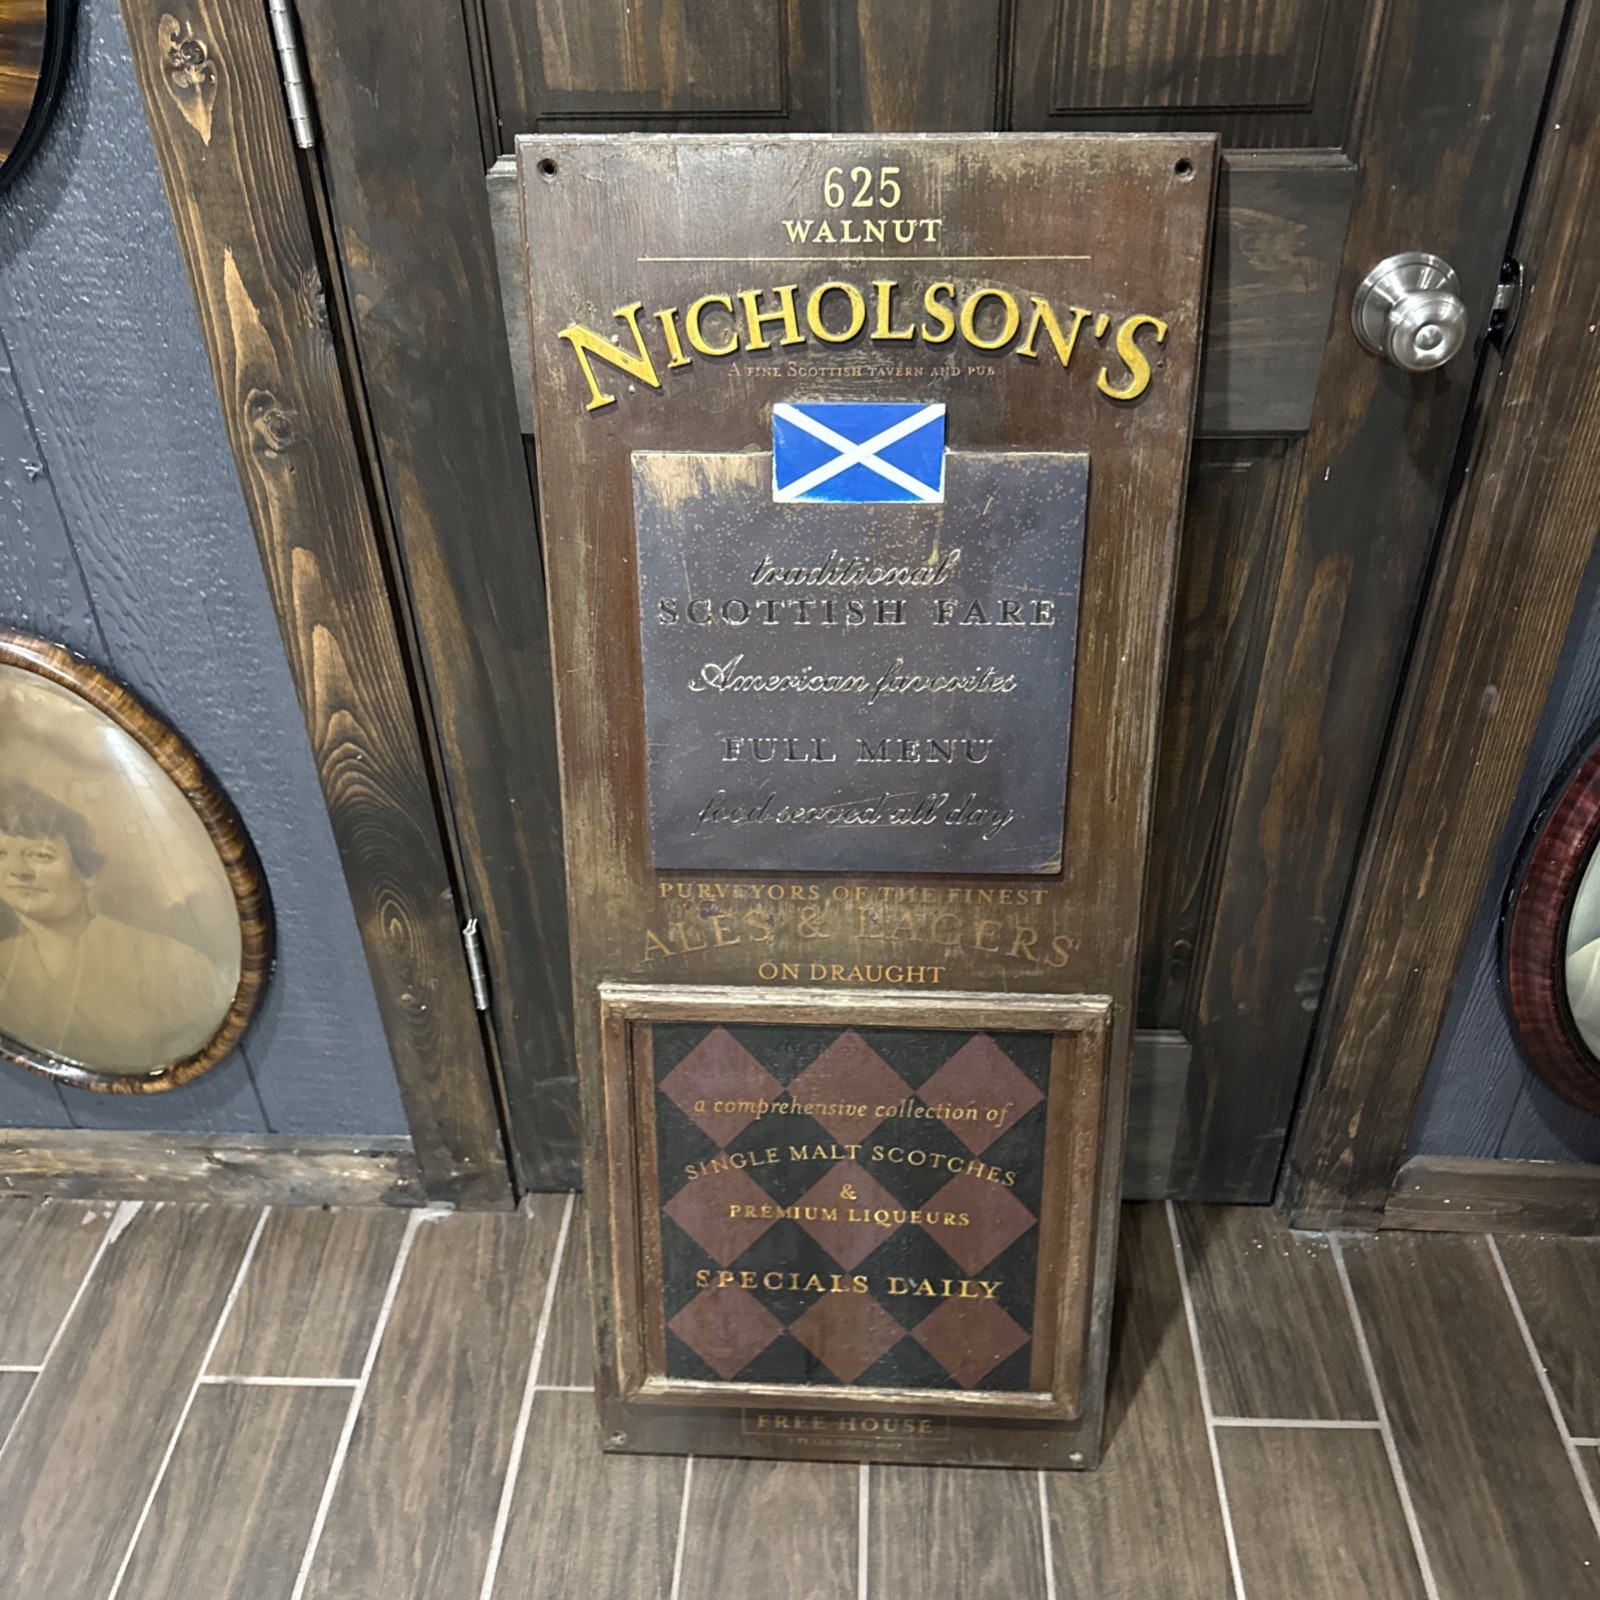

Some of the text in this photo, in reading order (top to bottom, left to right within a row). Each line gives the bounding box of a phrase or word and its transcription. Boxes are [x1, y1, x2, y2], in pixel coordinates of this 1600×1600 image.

[823, 167, 901, 208] 625
[782, 219, 942, 244] WALNUT
[558, 280, 1168, 412] NICHOLSON'S
[728, 362, 741, 377] A
[931, 366, 960, 377] AND
[750, 549, 961, 586] traditional
[658, 599, 1057, 627] SCOTTISH FARE
[688, 654, 1017, 706] American favorites
[722, 737, 993, 764] FULL MENU
[691, 788, 1015, 841] food served all day
[658, 882, 1048, 906] PURVEYORS OF THE FINEST
[640, 906, 1077, 969] ALES & LAGERS
[758, 962, 946, 985] ON DRAUGHT
[693, 1097, 1014, 1128] a comprehensive collection of
[684, 1144, 1020, 1188] SINGLE MALT SCOTCHES
[839, 1183, 858, 1200] &
[729, 1204, 971, 1227] PREMIUM LIQUEURS
[695, 1269, 1003, 1299] SPECIALS DAILY
[756, 1414, 934, 1434] FREE HOUSE
